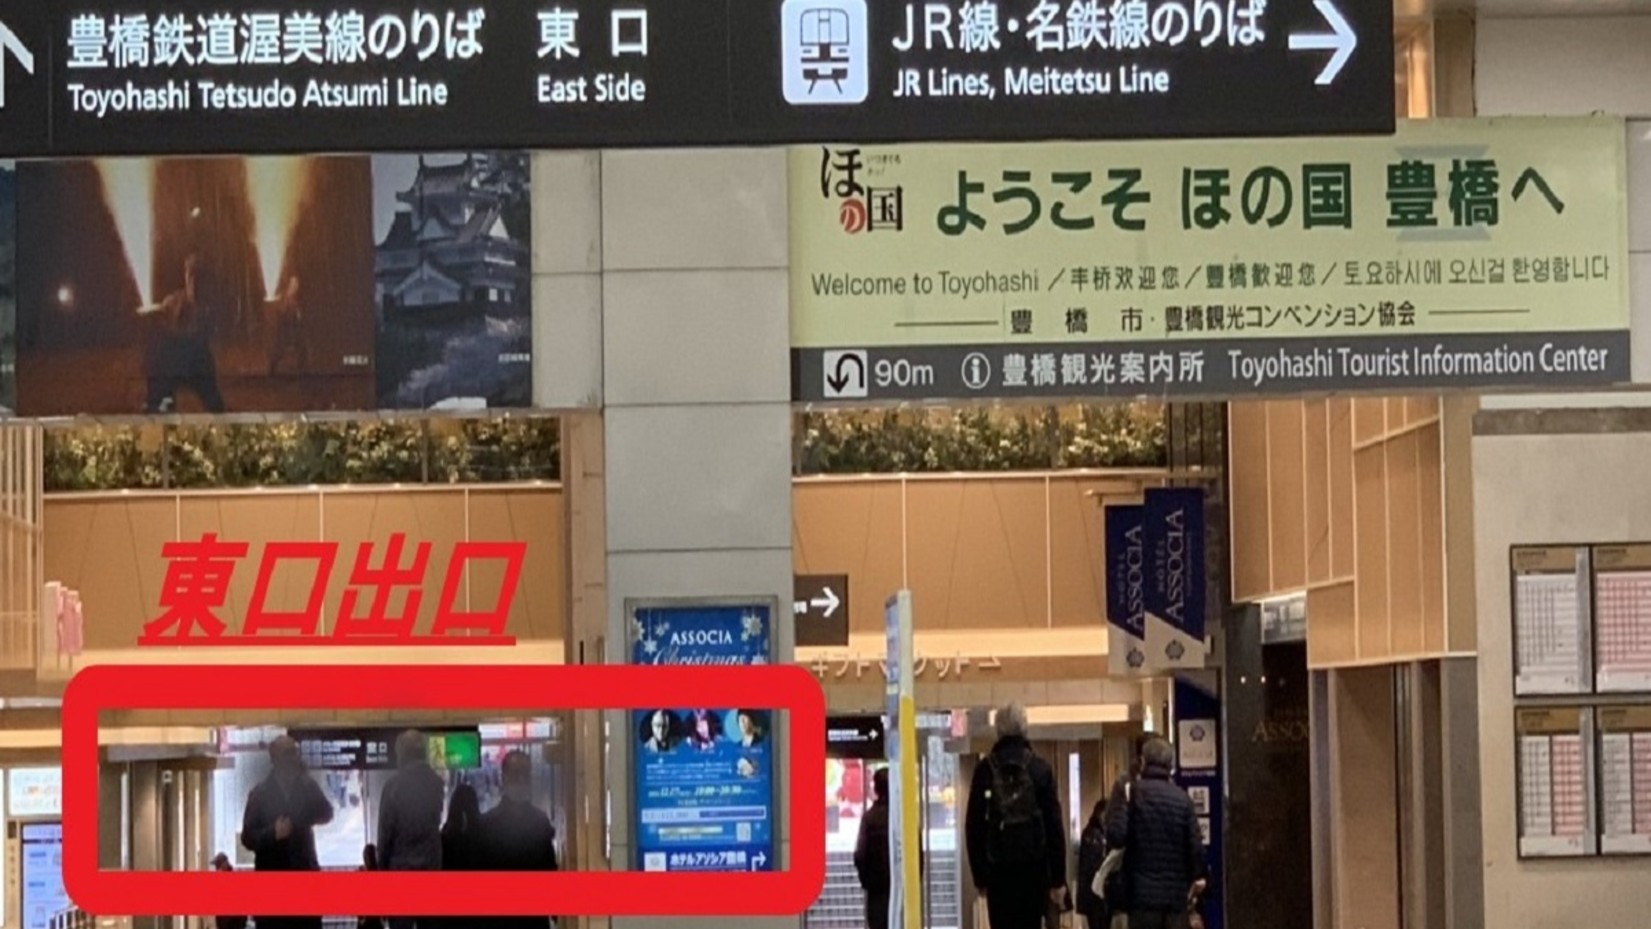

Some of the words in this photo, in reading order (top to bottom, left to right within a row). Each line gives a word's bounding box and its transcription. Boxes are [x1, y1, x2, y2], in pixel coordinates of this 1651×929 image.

[67, 8, 485, 68] 豊橋鉄道渥美線のりば
[67, 80, 190, 118] Toyohashi
[198, 78, 296, 108] Tetsudo
[302, 78, 388, 107] Atsumi
[398, 77, 448, 105] Line
[537, 75, 588, 102] East
[595, 72, 646, 101] Side
[893, 68, 921, 97] JR
[928, 67, 996, 100] Lines,
[1004, 65, 1112, 95] Meitetsu
[1119, 64, 1170, 93] Line
[937, 167, 1150, 236] ようこそ
[1182, 162, 1352, 231] ほの国
[1386, 158, 1565, 228] 豊橋へ
[812, 272, 906, 297] Welcome
[914, 271, 933, 295] to
[938, 270, 1039, 300] Toyohashi
[1344, 259, 1442, 286] 토요하시에
[1513, 255, 1610, 284] 환영합니다
[874, 358, 934, 386] 90m
[1002, 350, 1205, 387] 豊橋観光案内所
[1228, 348, 1333, 386] Toyohashi
[1337, 345, 1410, 378] Tourist
[1414, 344, 1534, 376] Information
[1539, 342, 1608, 373] Center
[1124, 525, 1143, 631] ASSOCIA
[1165, 509, 1185, 622] ASSOCIA
[670, 630, 733, 645] ASSOCIA
